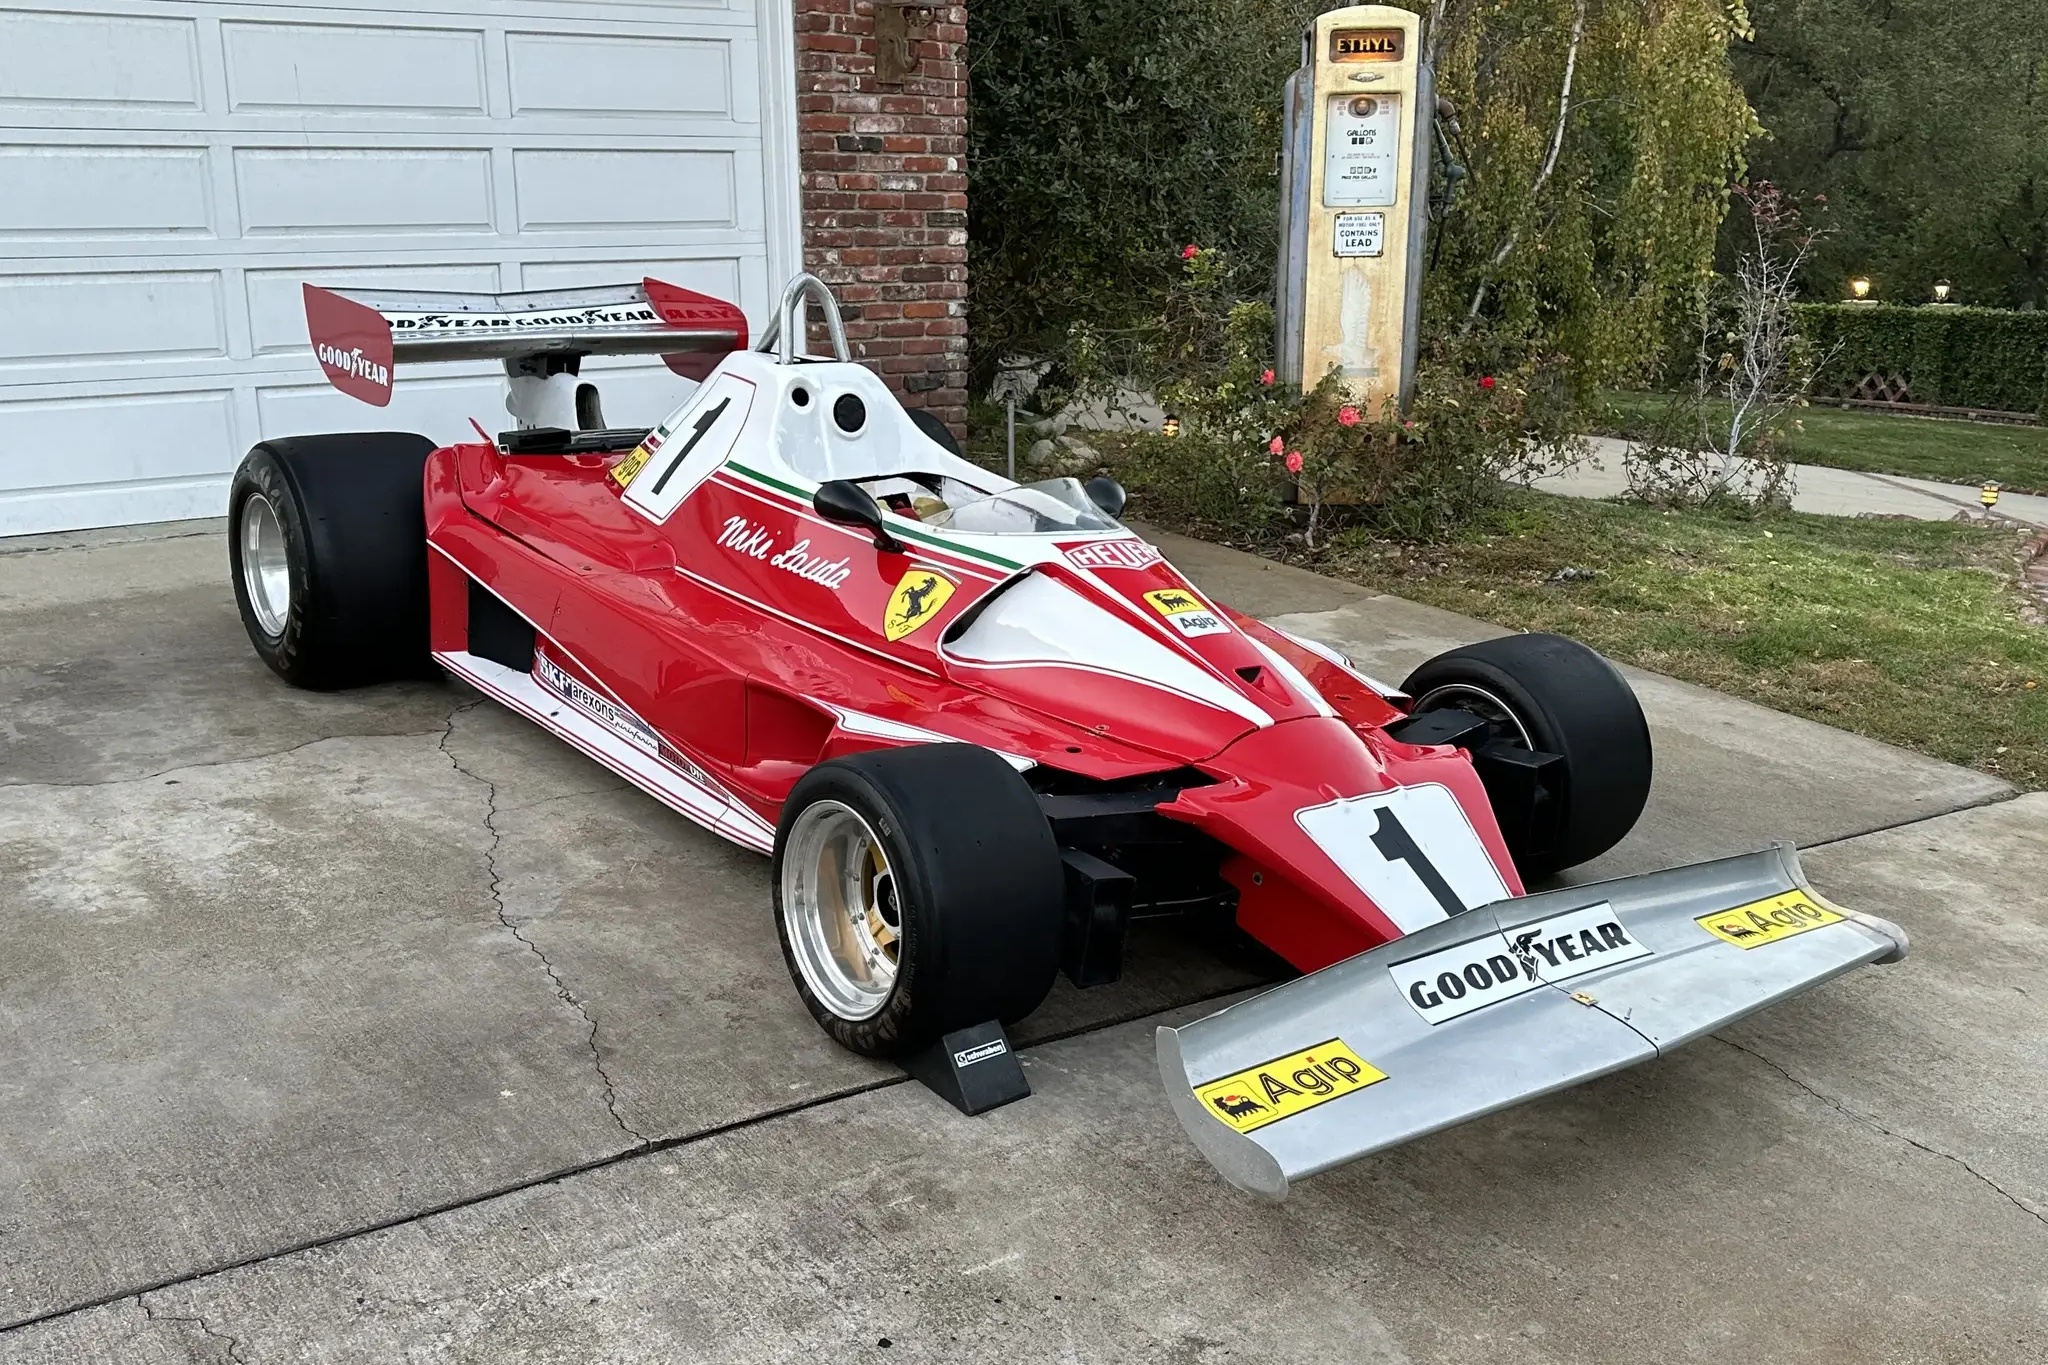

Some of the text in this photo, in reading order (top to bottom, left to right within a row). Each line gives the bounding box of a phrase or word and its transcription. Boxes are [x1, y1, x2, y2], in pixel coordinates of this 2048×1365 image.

[1336, 37, 1394, 53] ETHYL
[1346, 129, 1377, 137] GALLONS
[1340, 229, 1379, 237] CONTAINS
[1345, 238, 1372, 247] LEAD
[651, 396, 732, 495] 1
[717, 515, 851, 589] Niki Lauda
[1179, 614, 1218, 629] Agip
[540, 656, 572, 691] SKF
[573, 685, 614, 720] arexons
[1368, 806, 1468, 918] 1
[1745, 901, 1824, 932] Agip
[1258, 1055, 1361, 1105] Agip
